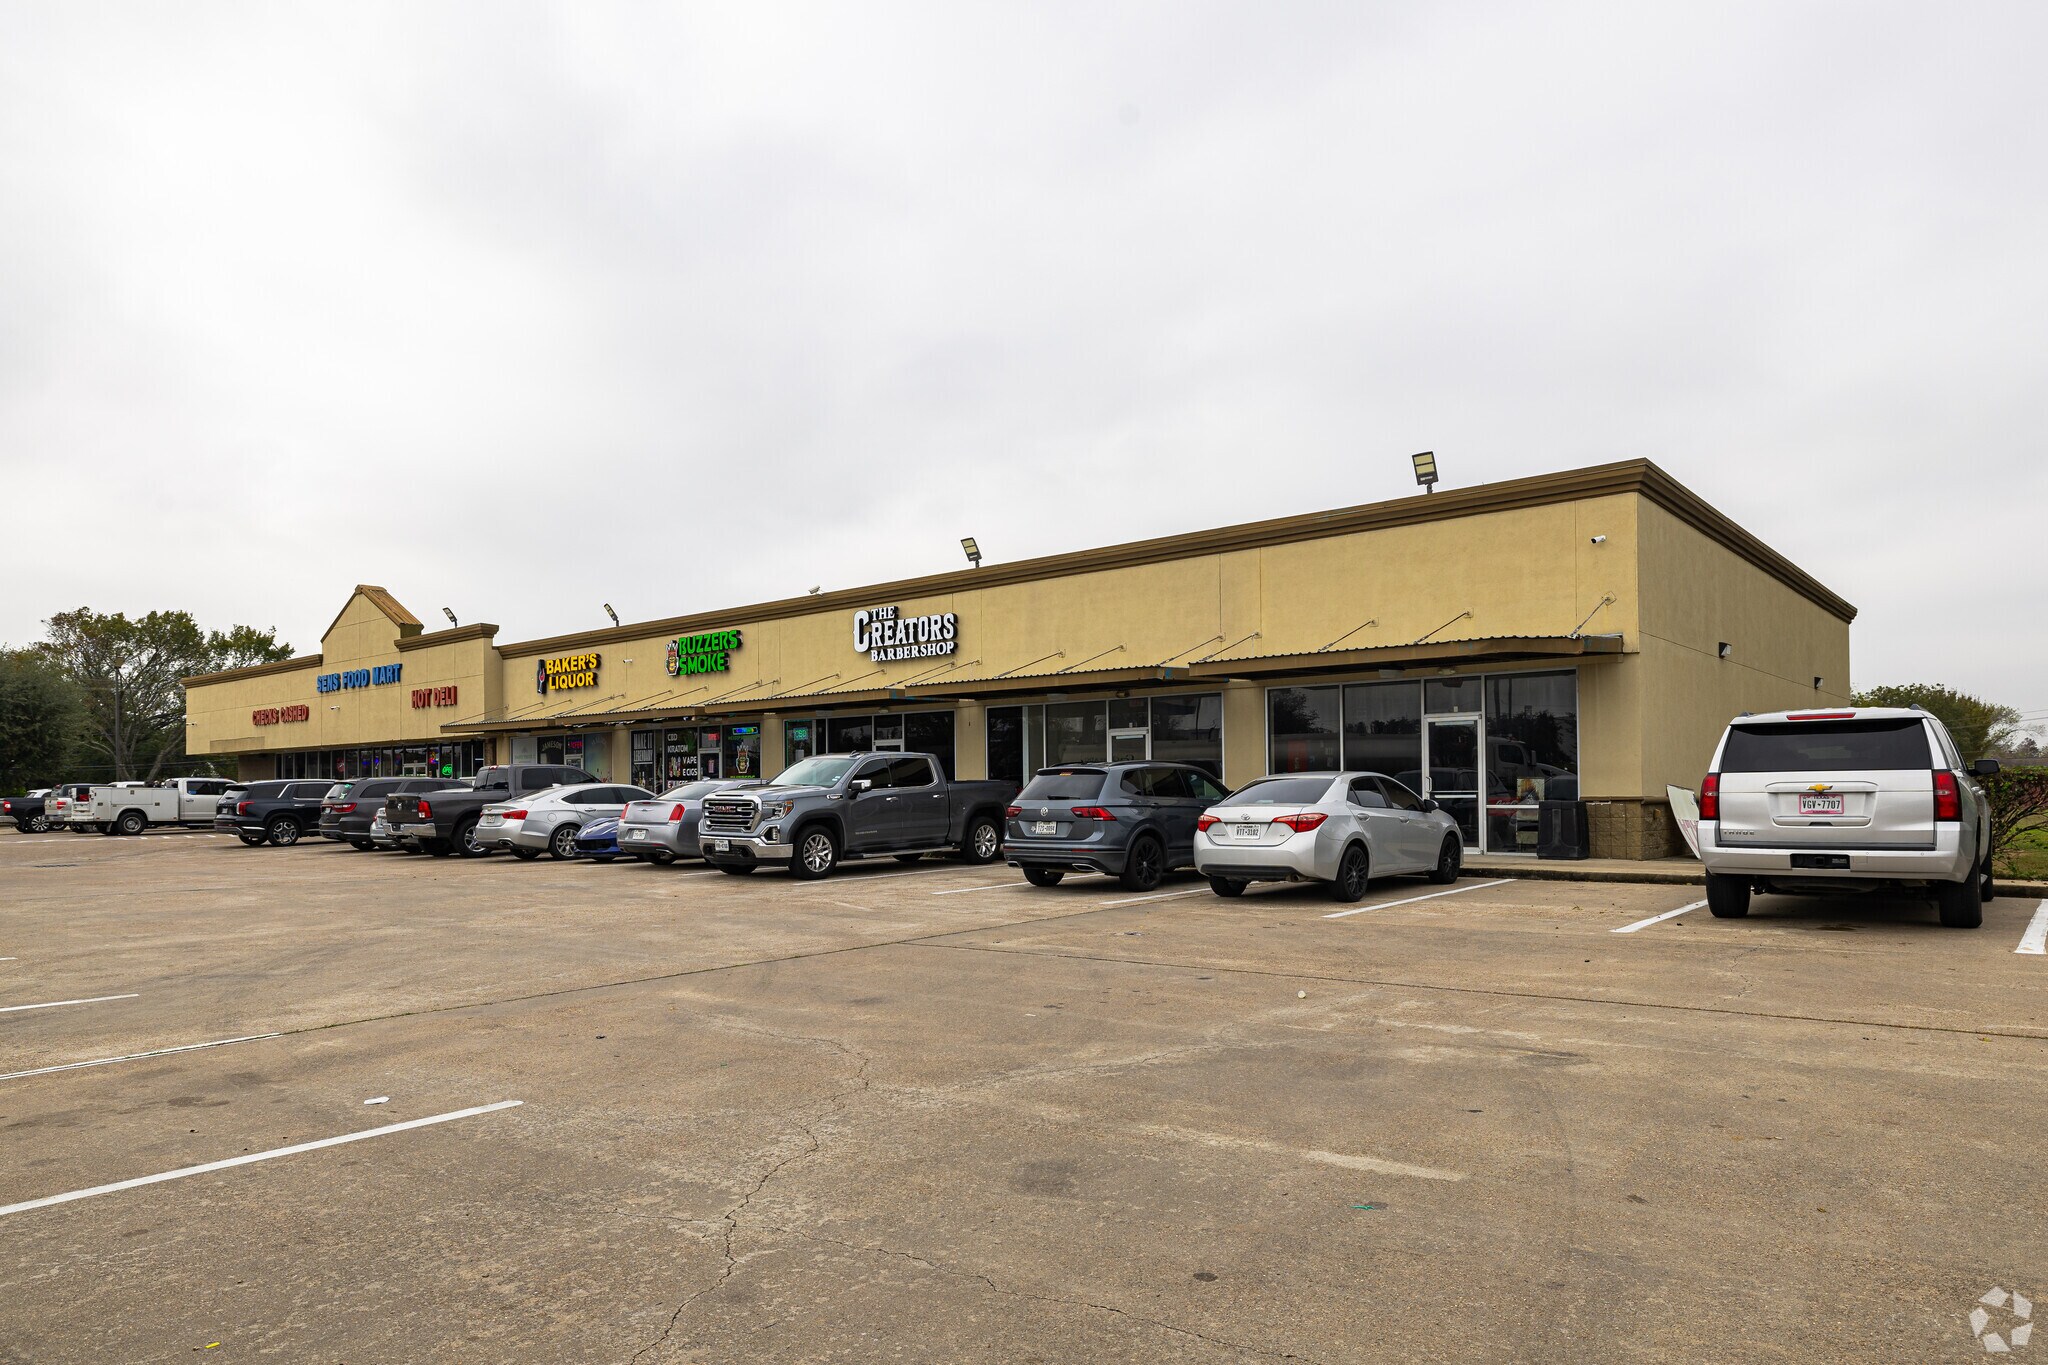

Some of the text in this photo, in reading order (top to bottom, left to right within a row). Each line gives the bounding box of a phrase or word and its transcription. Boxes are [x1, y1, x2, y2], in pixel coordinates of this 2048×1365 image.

[871, 606, 895, 620] THE
[678, 630, 738, 655] BUZZERS
[853, 610, 955, 653] CREATORS
[870, 641, 955, 662] BARBERSHOP
[546, 653, 598, 675] BAKER'S
[679, 652, 726, 676] SMOKE
[316, 663, 402, 693] SENS FOOD MART
[549, 672, 595, 690] LIQUOR
[411, 685, 458, 710] HOT DELI
[252, 704, 309, 726] CHECKS CASHED
[667, 733, 678, 741] CBD
[682, 756, 697, 764] VAPE
